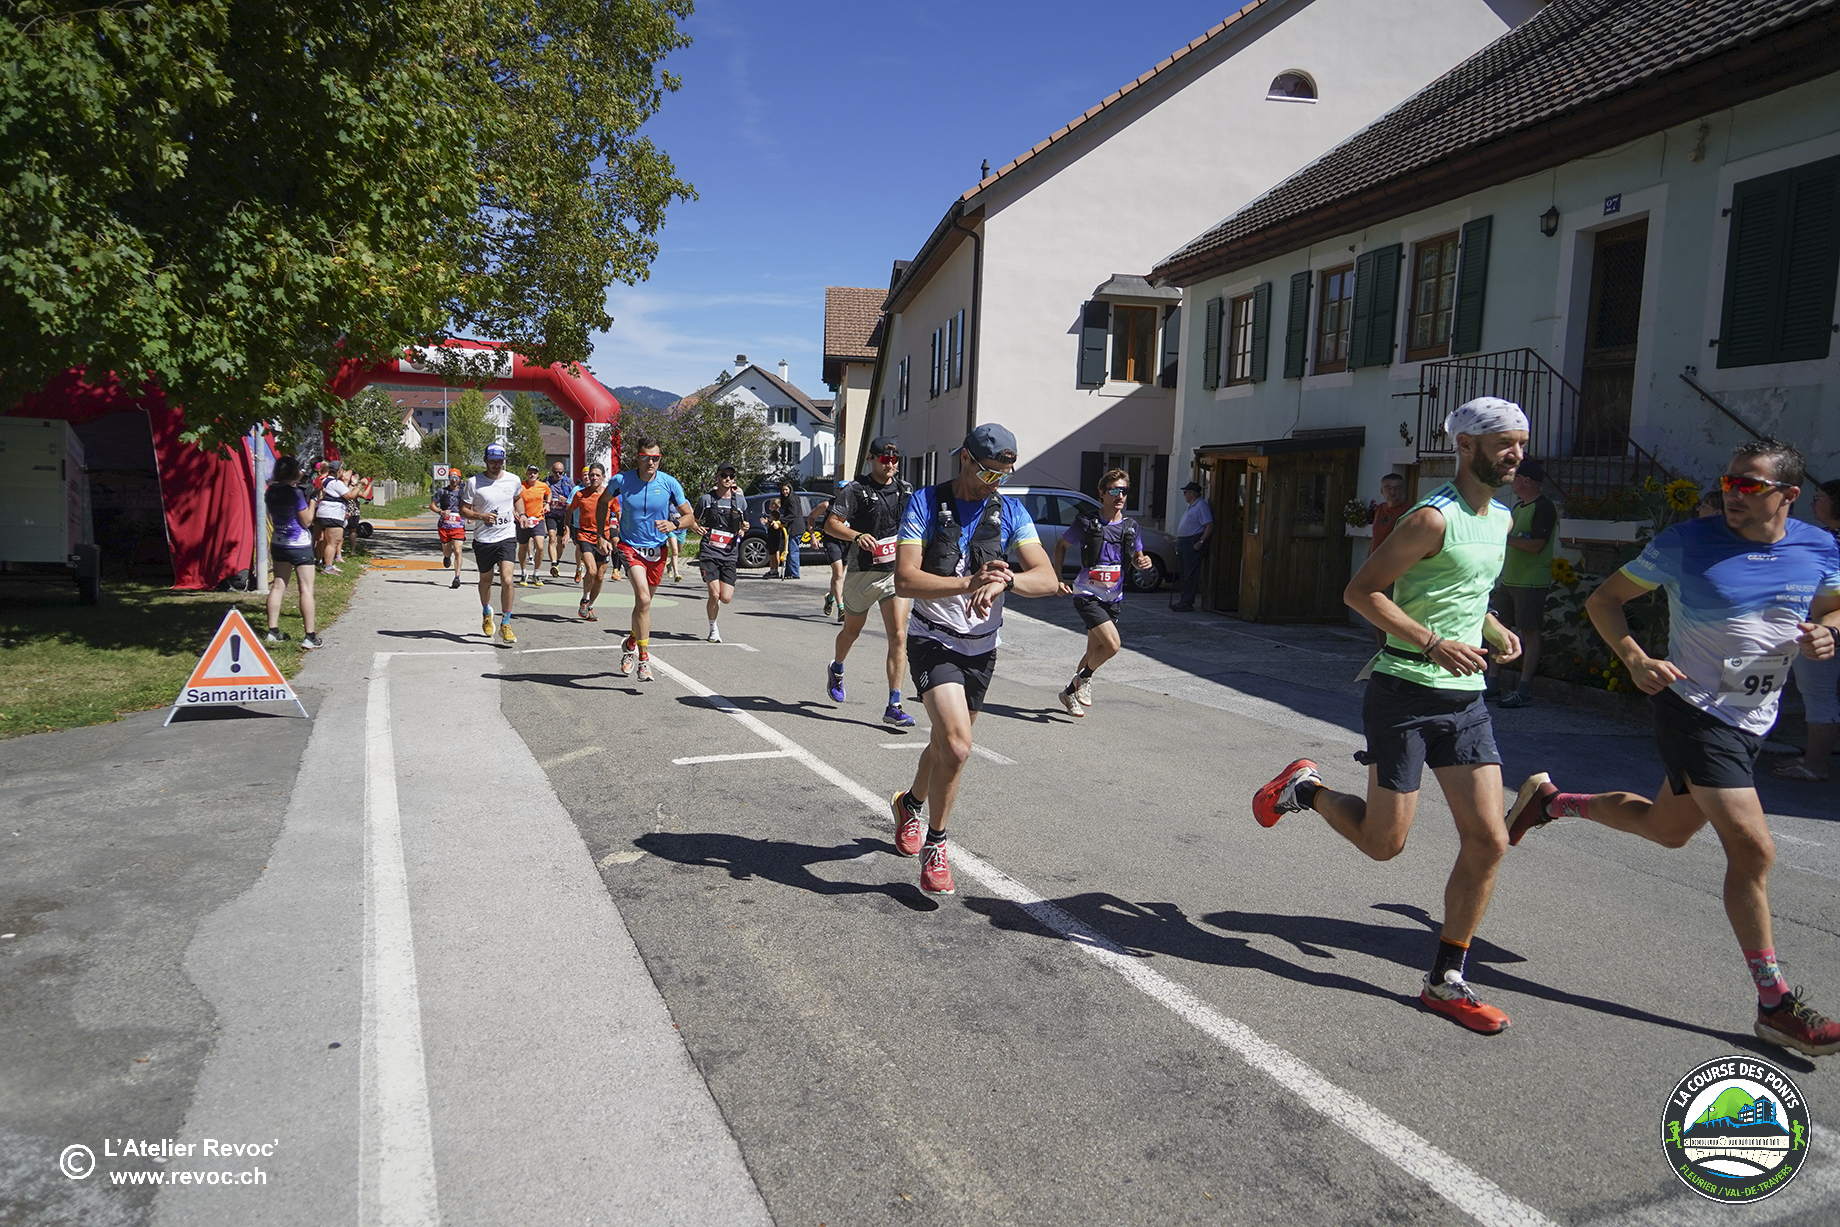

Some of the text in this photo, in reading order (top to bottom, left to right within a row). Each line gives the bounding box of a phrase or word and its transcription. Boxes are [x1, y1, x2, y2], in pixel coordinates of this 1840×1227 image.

[1606, 198, 1618, 212] 27
[882, 544, 896, 554] 65
[1100, 573, 1111, 581] 15
[1744, 675, 1774, 695] 95
[187, 686, 286, 703] Samaritain
